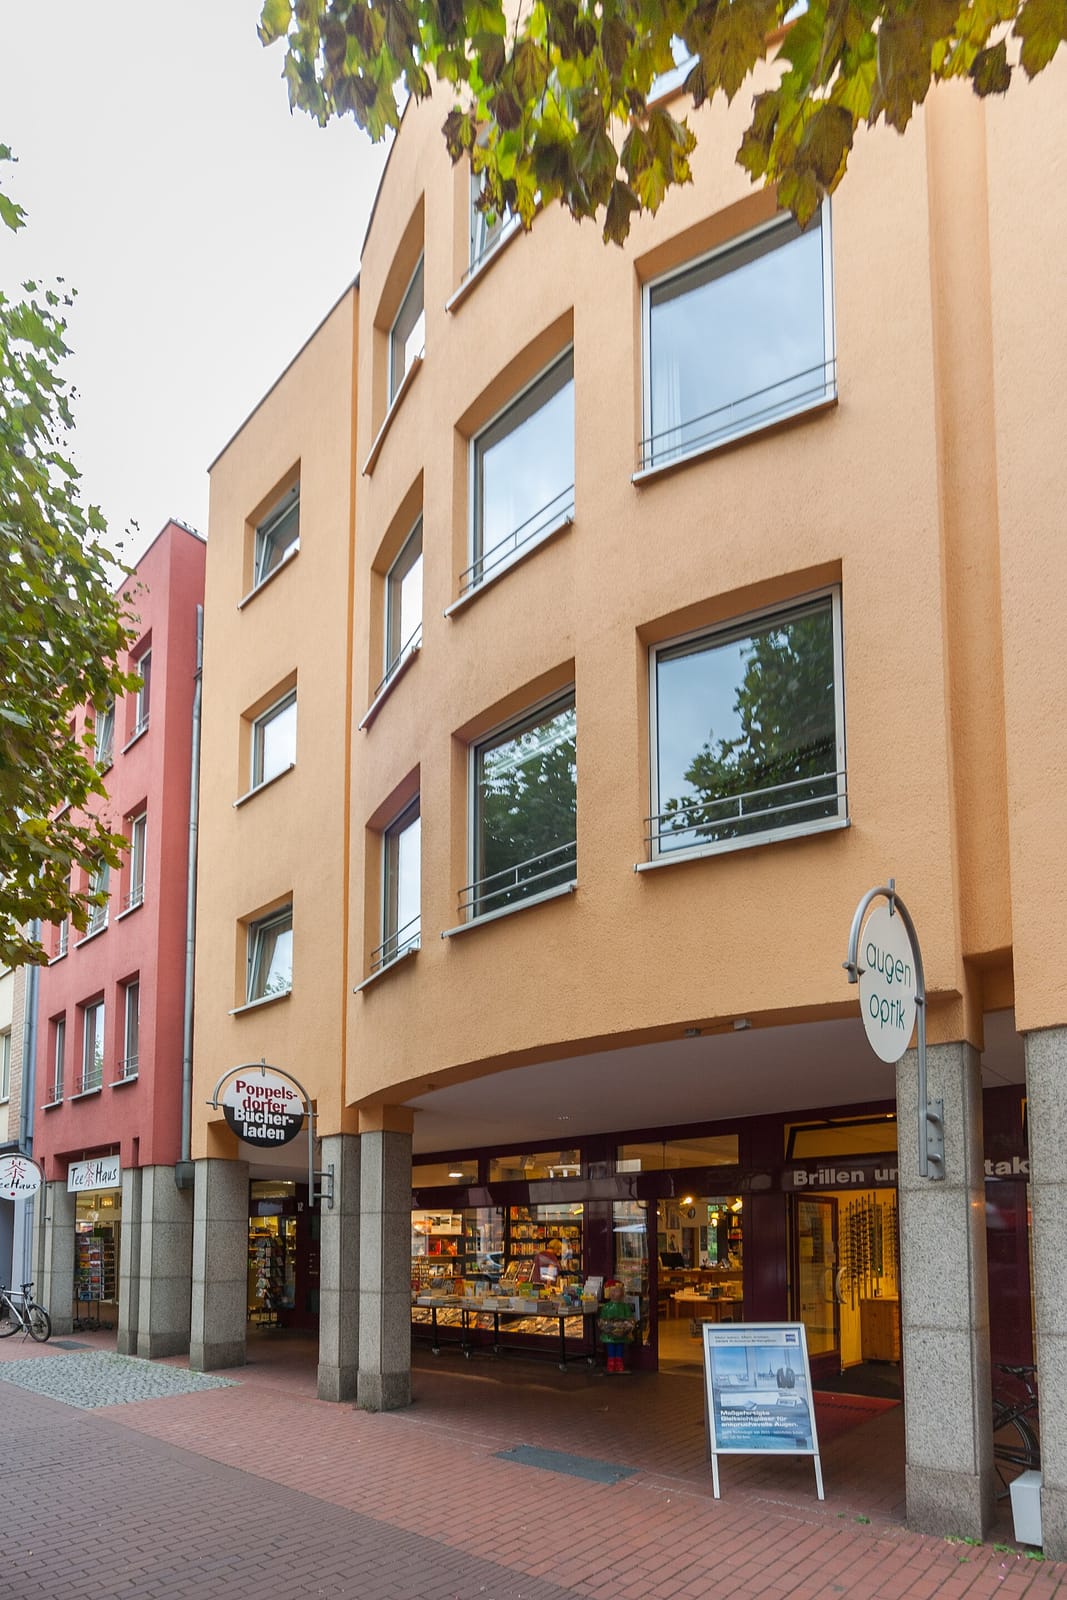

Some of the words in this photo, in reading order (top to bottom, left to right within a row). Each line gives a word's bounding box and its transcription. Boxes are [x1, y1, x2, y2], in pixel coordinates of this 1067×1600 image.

[866, 942, 912, 988] augen
[235, 1080, 298, 1100] Poppels-
[242, 1096, 287, 1114] dorfer
[243, 1122, 285, 1140] laden
[793, 1168, 865, 1186] Brillen
[297, 1202, 304, 1213] 12
